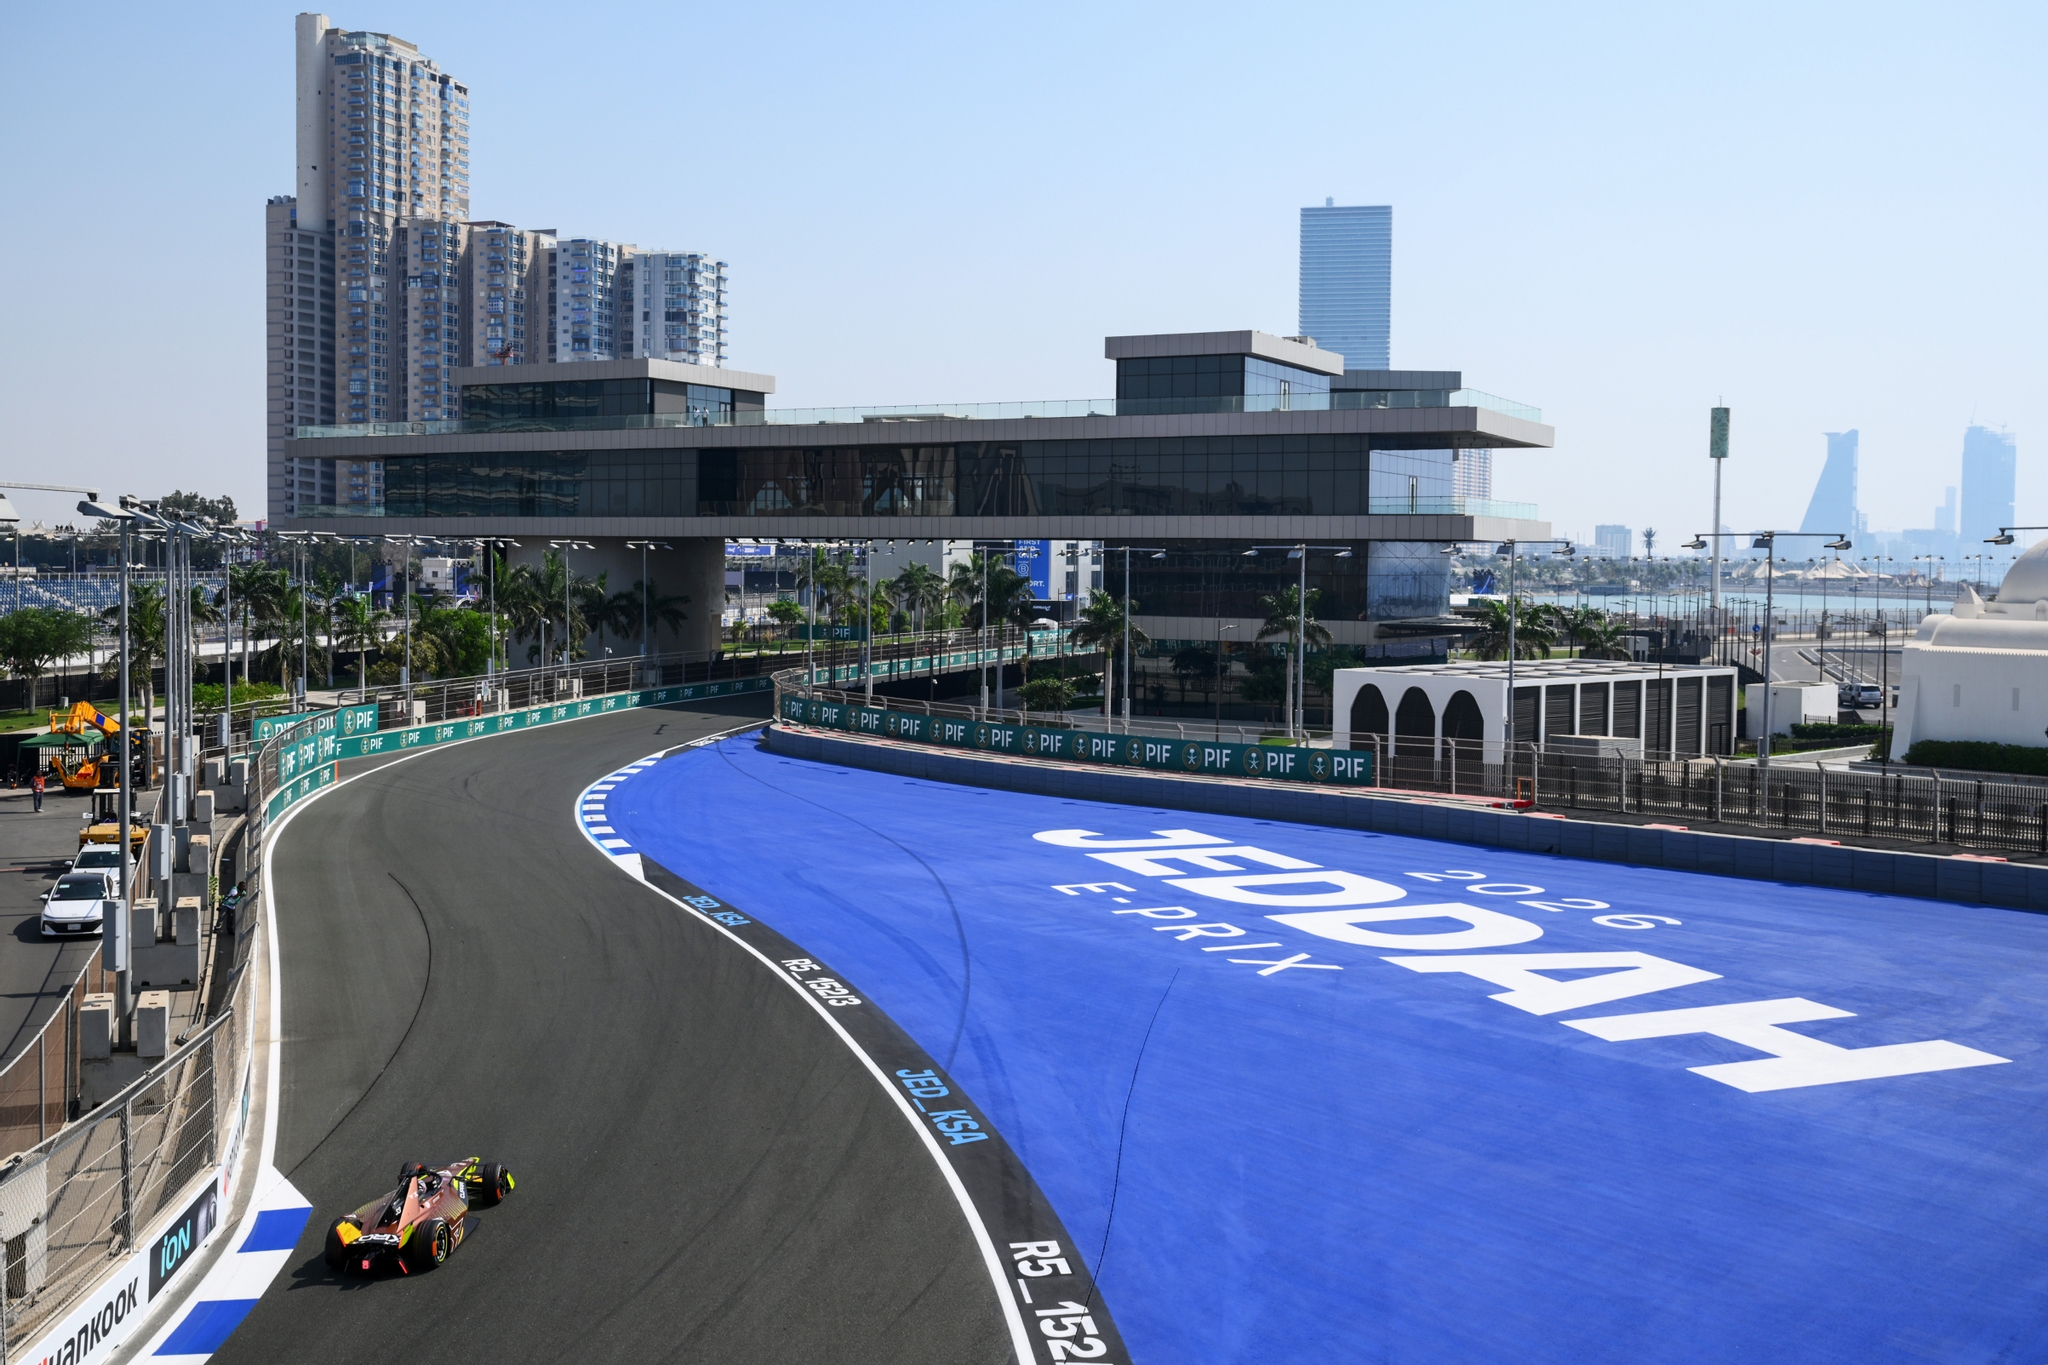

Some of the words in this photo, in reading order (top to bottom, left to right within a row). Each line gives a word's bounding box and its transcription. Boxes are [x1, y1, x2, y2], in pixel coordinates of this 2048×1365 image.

[684, 688, 693, 697] PIF
[710, 685, 719, 694] PIF
[735, 682, 744, 691] PIF
[607, 698, 616, 709] PIF
[631, 694, 641, 705] PIF
[657, 691, 666, 701] PIF
[557, 707, 567, 718] PIF
[582, 702, 591, 713] PIF
[791, 701, 803, 717] PIF
[821, 706, 839, 723] PIF
[356, 710, 374, 730] PIF
[504, 716, 514, 728] PIF
[531, 712, 541, 723] PIF
[860, 712, 880, 729] PIF
[442, 726, 454, 738] PIF
[474, 721, 485, 733] PIF
[900, 718, 921, 736] PIF
[945, 723, 965, 741] PIF
[370, 737, 383, 750] PIF
[408, 731, 421, 744] PIF
[991, 729, 1014, 747] PIF
[1040, 734, 1063, 753] PIF
[303, 743, 315, 765] PIF
[1091, 738, 1116, 758] PIF
[1146, 744, 1171, 763] PIF
[1204, 748, 1232, 768] PIF
[1266, 752, 1296, 773] PIF
[1333, 756, 1365, 779] PIF
[1403, 869, 1683, 931] 2026
[682, 895, 751, 927] JED_KSA
[1051, 882, 1344, 976] E-PRIX
[1031, 828, 2013, 1093] JEDDAH
[895, 1068, 989, 1146] JED_KSA
[1009, 1239, 1112, 1365] R5_152
